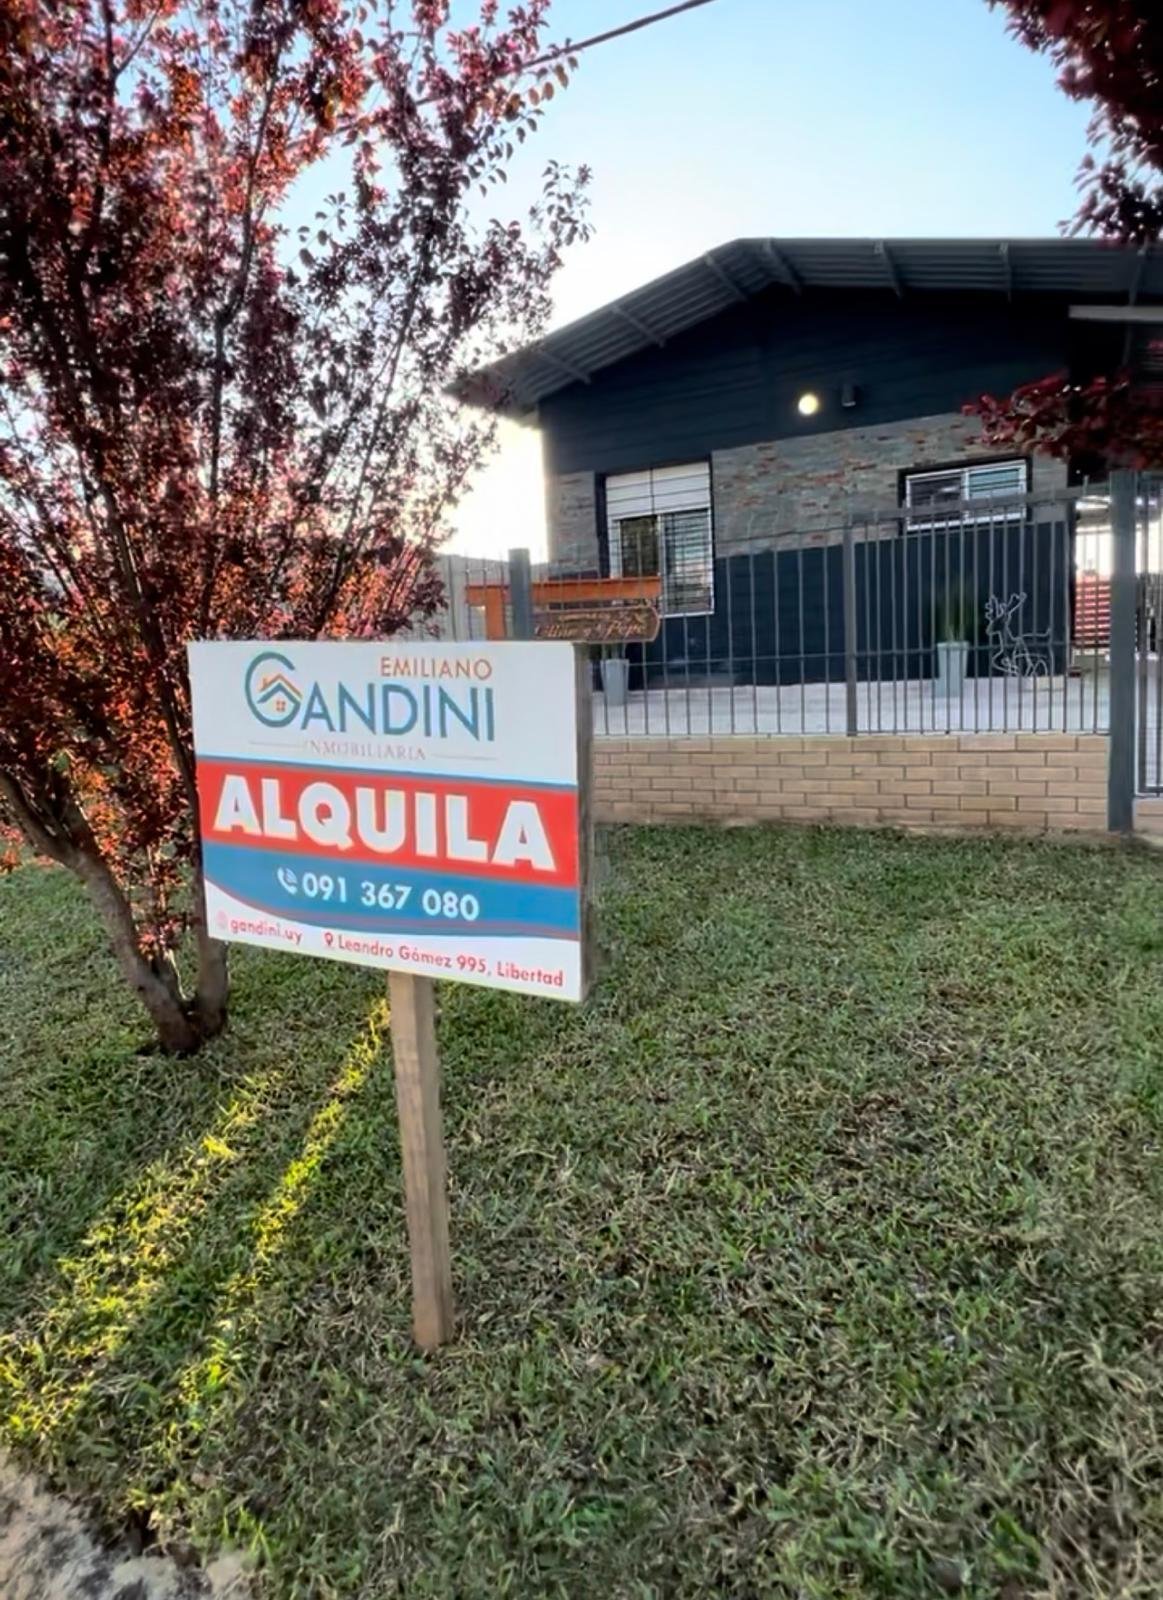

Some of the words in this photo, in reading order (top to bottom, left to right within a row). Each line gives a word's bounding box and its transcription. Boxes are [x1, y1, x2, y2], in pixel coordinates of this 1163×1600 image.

[380, 656, 493, 681] EMILIANO
[244, 651, 496, 742] GANDINI
[212, 774, 557, 872] ALQUILA
[302, 873, 348, 902] 091
[361, 881, 412, 910] 367
[422, 889, 479, 921] 080
[229, 919, 304, 946] gandini.uy
[337, 934, 394, 958] Leandro
[398, 945, 453, 969] Gómez
[456, 954, 493, 977] 995,
[497, 960, 564, 987] Libertad
